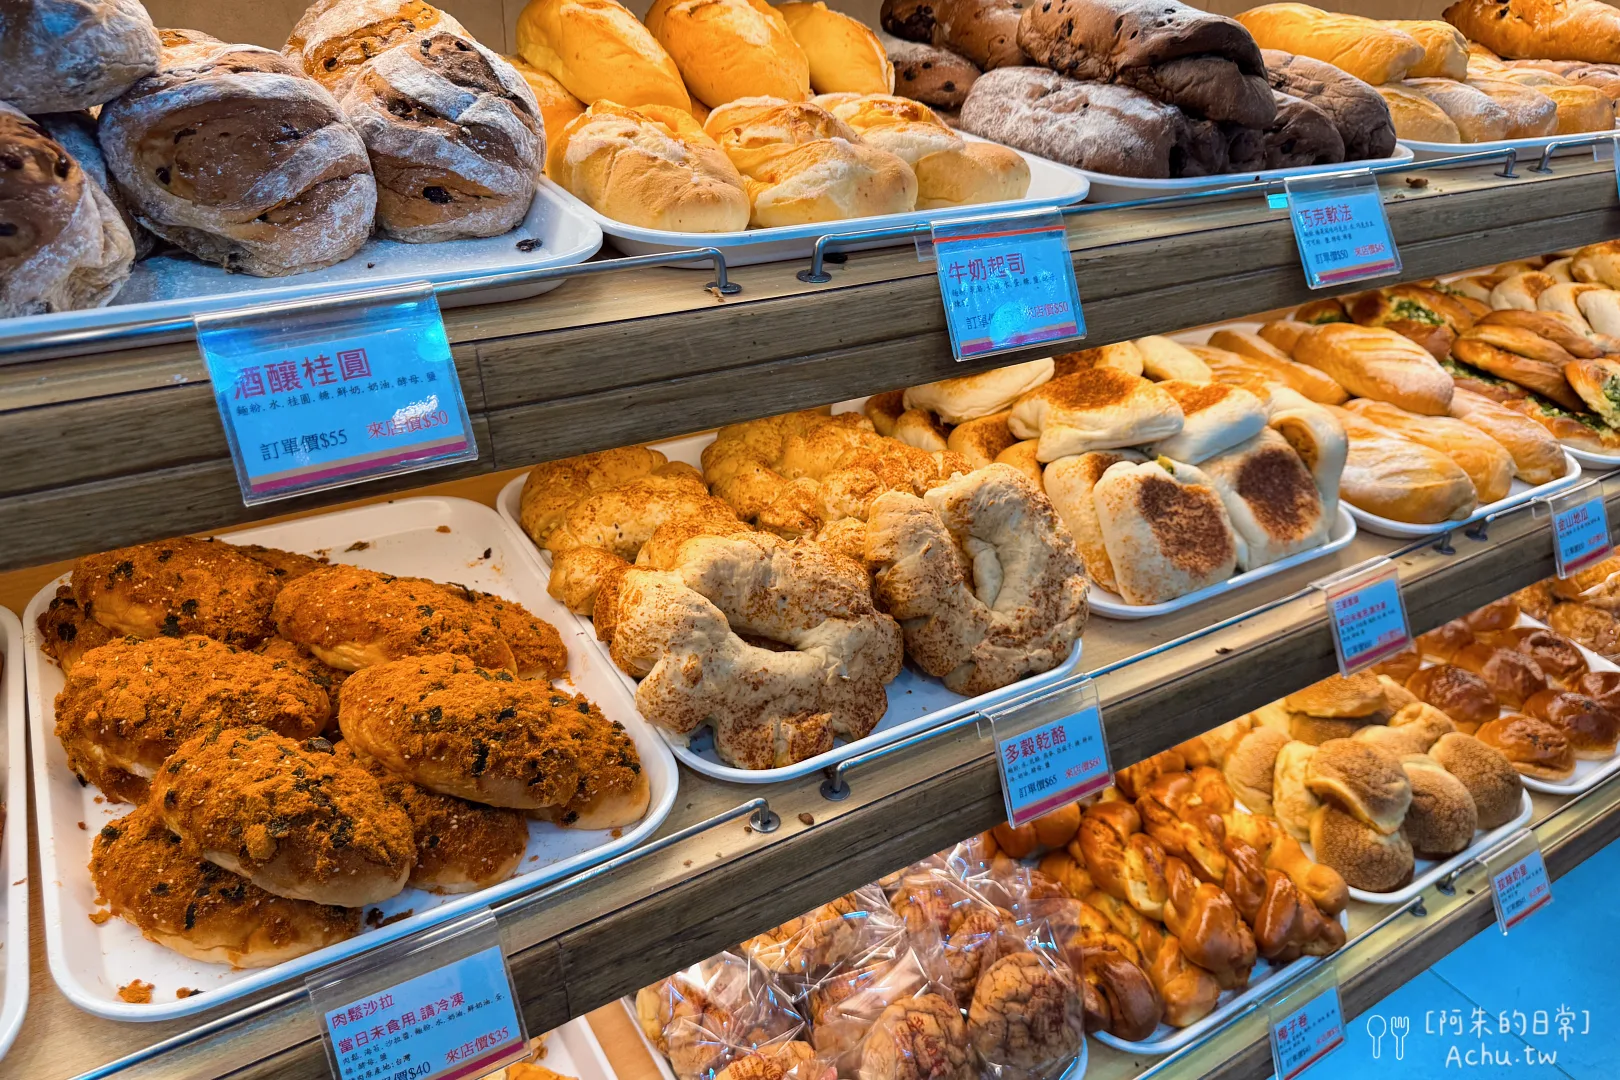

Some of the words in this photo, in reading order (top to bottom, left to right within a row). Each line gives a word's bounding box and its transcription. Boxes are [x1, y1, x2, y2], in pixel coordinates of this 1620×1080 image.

[948, 252, 1026, 285] 牛奶起司
[233, 348, 372, 401] 酒釀桂圓
[259, 428, 348, 462] 訂單價$55
[1004, 725, 1067, 765] 多穀乾酪
[1019, 774, 1058, 799] 訂單價$65
[331, 993, 395, 1030] 肉鬆沙拉
[445, 1026, 510, 1065] 來店價$35
